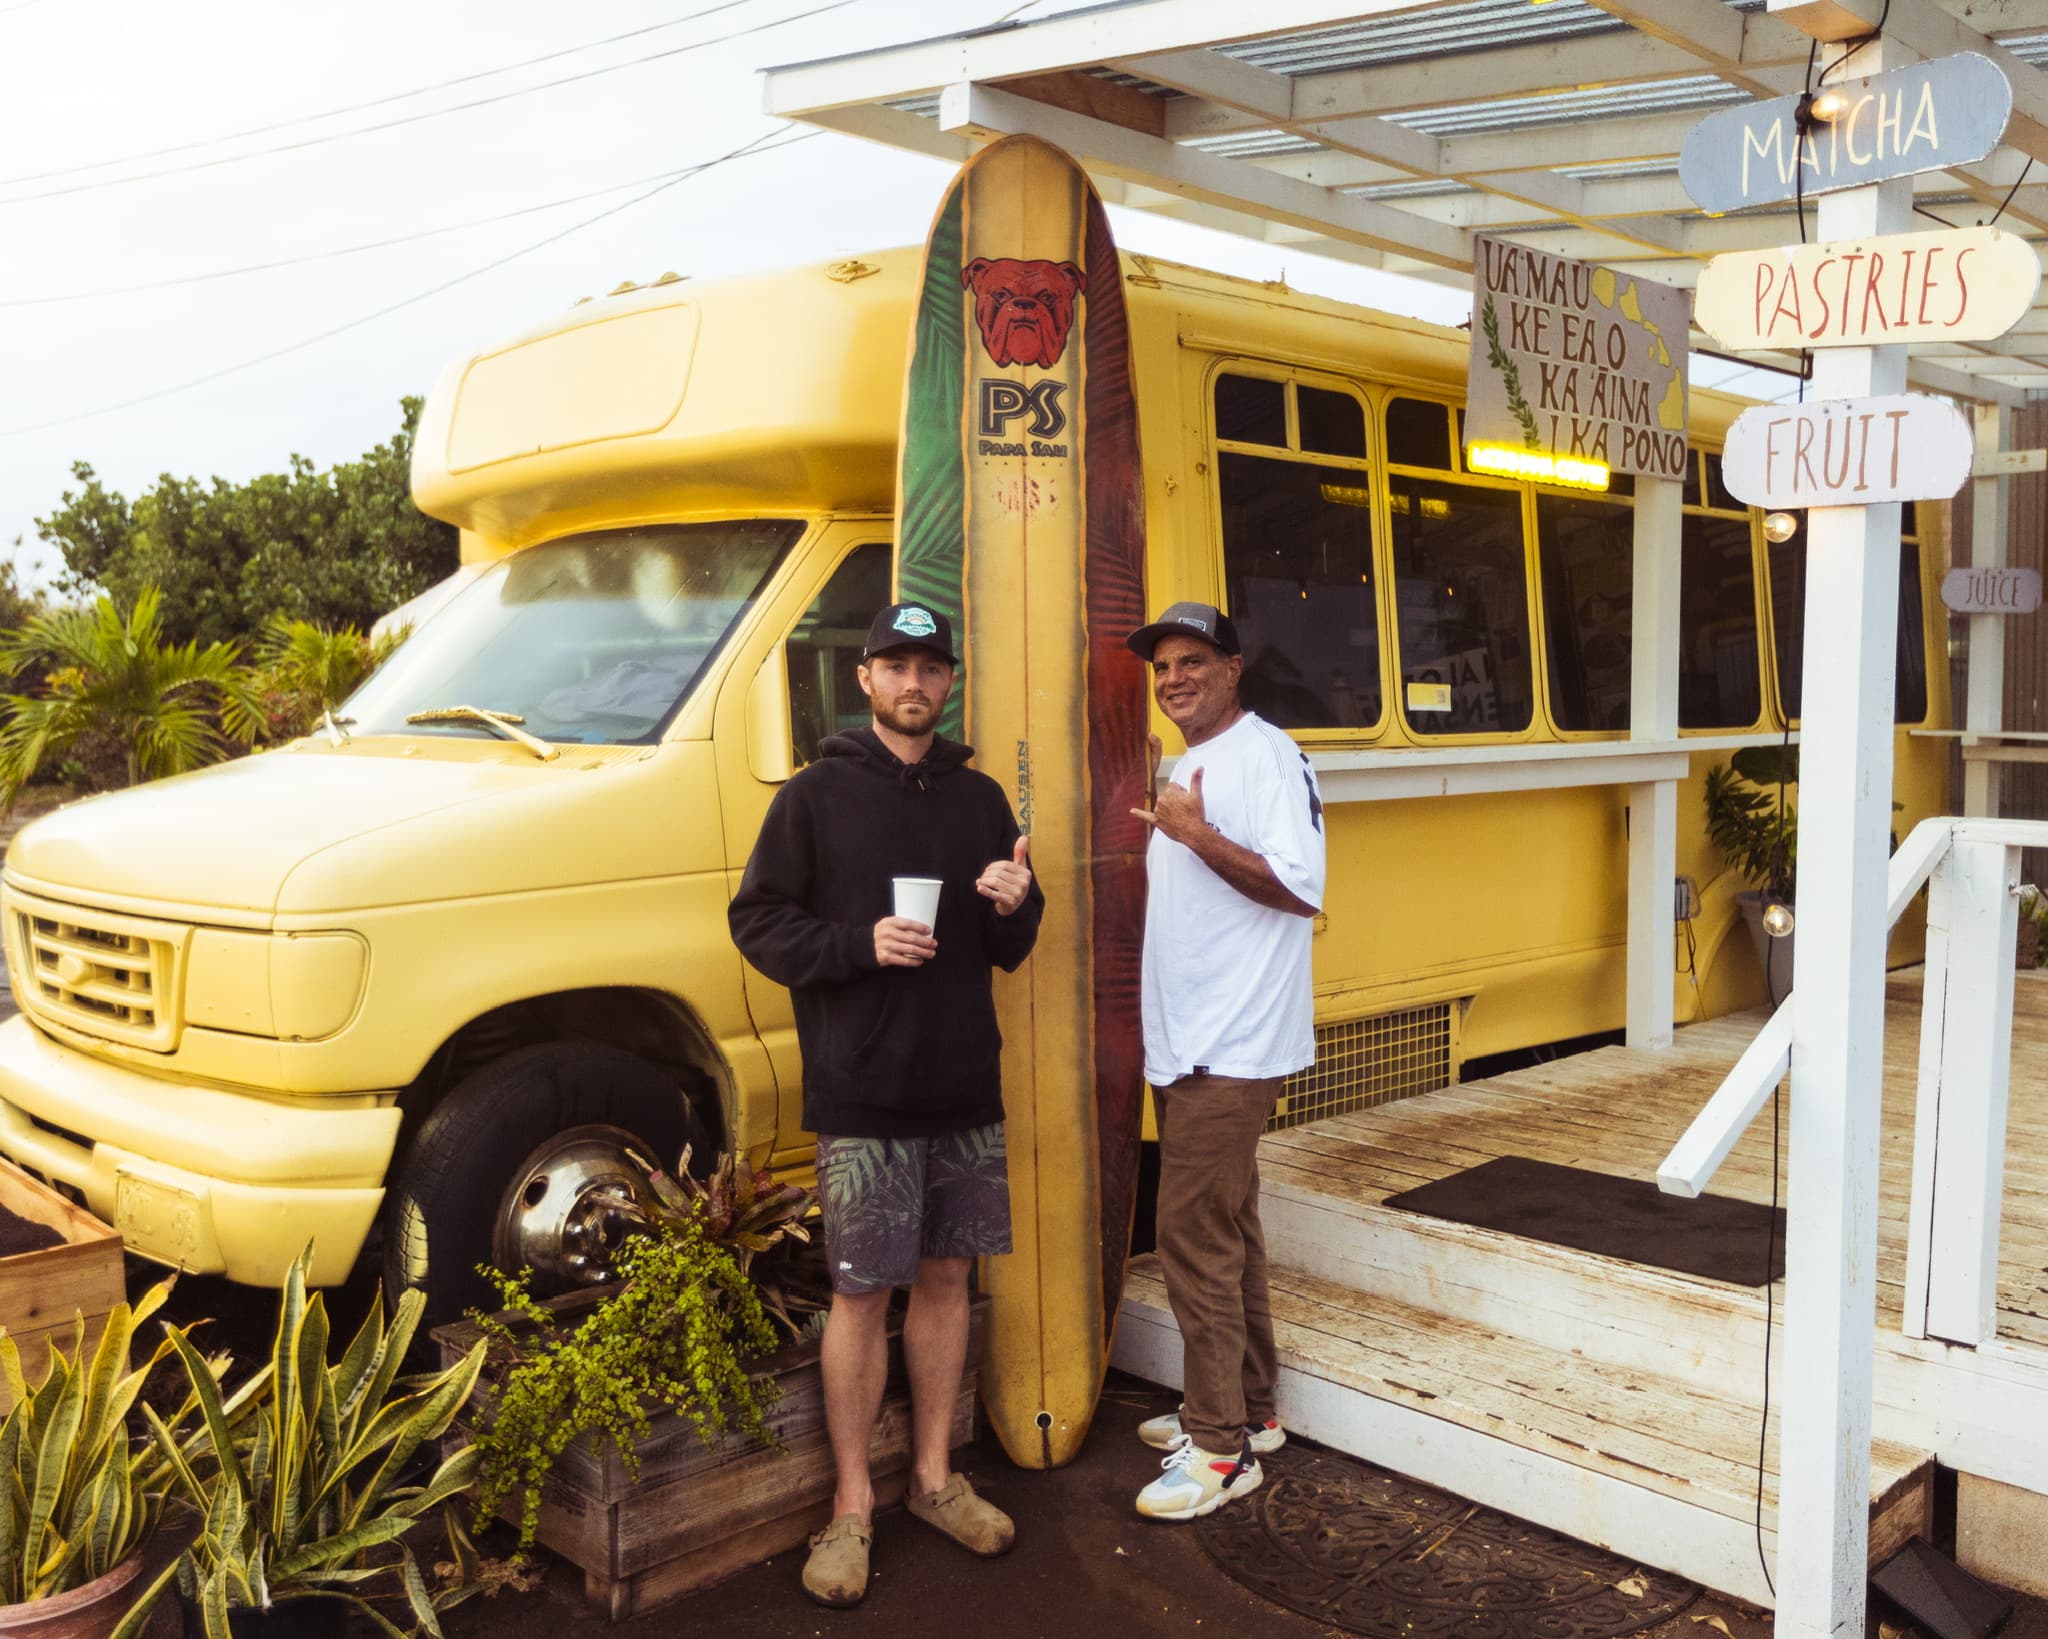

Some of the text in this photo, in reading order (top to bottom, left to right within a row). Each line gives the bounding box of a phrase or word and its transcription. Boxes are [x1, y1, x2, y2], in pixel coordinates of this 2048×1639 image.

[1742, 81, 1939, 197] MATCHA
[1482, 239, 1591, 310] UA MAU
[1755, 248, 1975, 339] PASTRIES
[1510, 301, 1626, 371] KE EA O
[979, 378, 1067, 439] PS
[1539, 361, 1579, 413] KA
[1569, 416, 1609, 463] KA
[1621, 425, 1686, 476] PONO
[1766, 410, 1910, 495] FRUIT
[1965, 575, 2022, 607] JUICE
